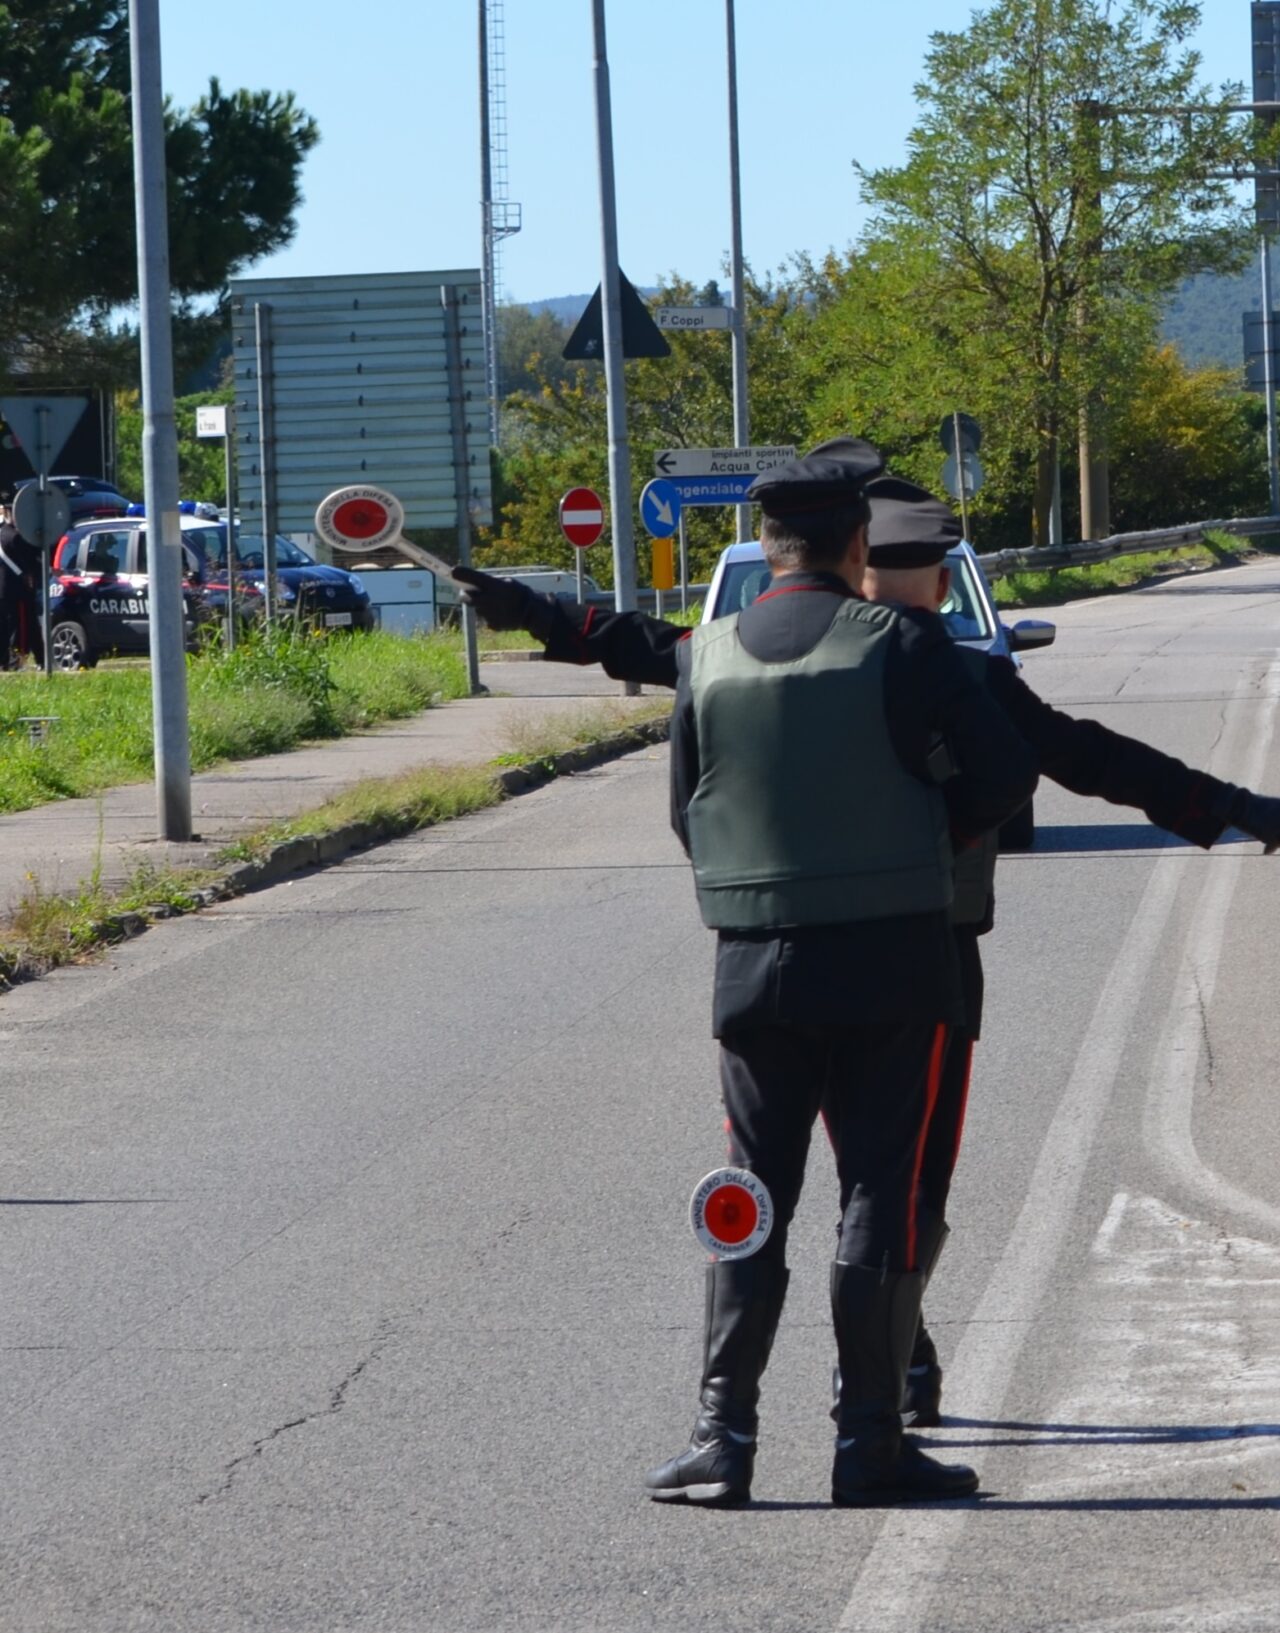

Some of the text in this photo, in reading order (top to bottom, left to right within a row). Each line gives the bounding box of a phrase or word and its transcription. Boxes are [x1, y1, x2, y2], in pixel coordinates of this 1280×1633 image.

[711, 449, 794, 459] impianti sportivi
[710, 461, 750, 473] Acqua
[675, 483, 745, 498] ngenziale
[90, 599, 188, 614] CARABII
[694, 1174, 768, 1231] MINISTERO DELLA DIFESA
